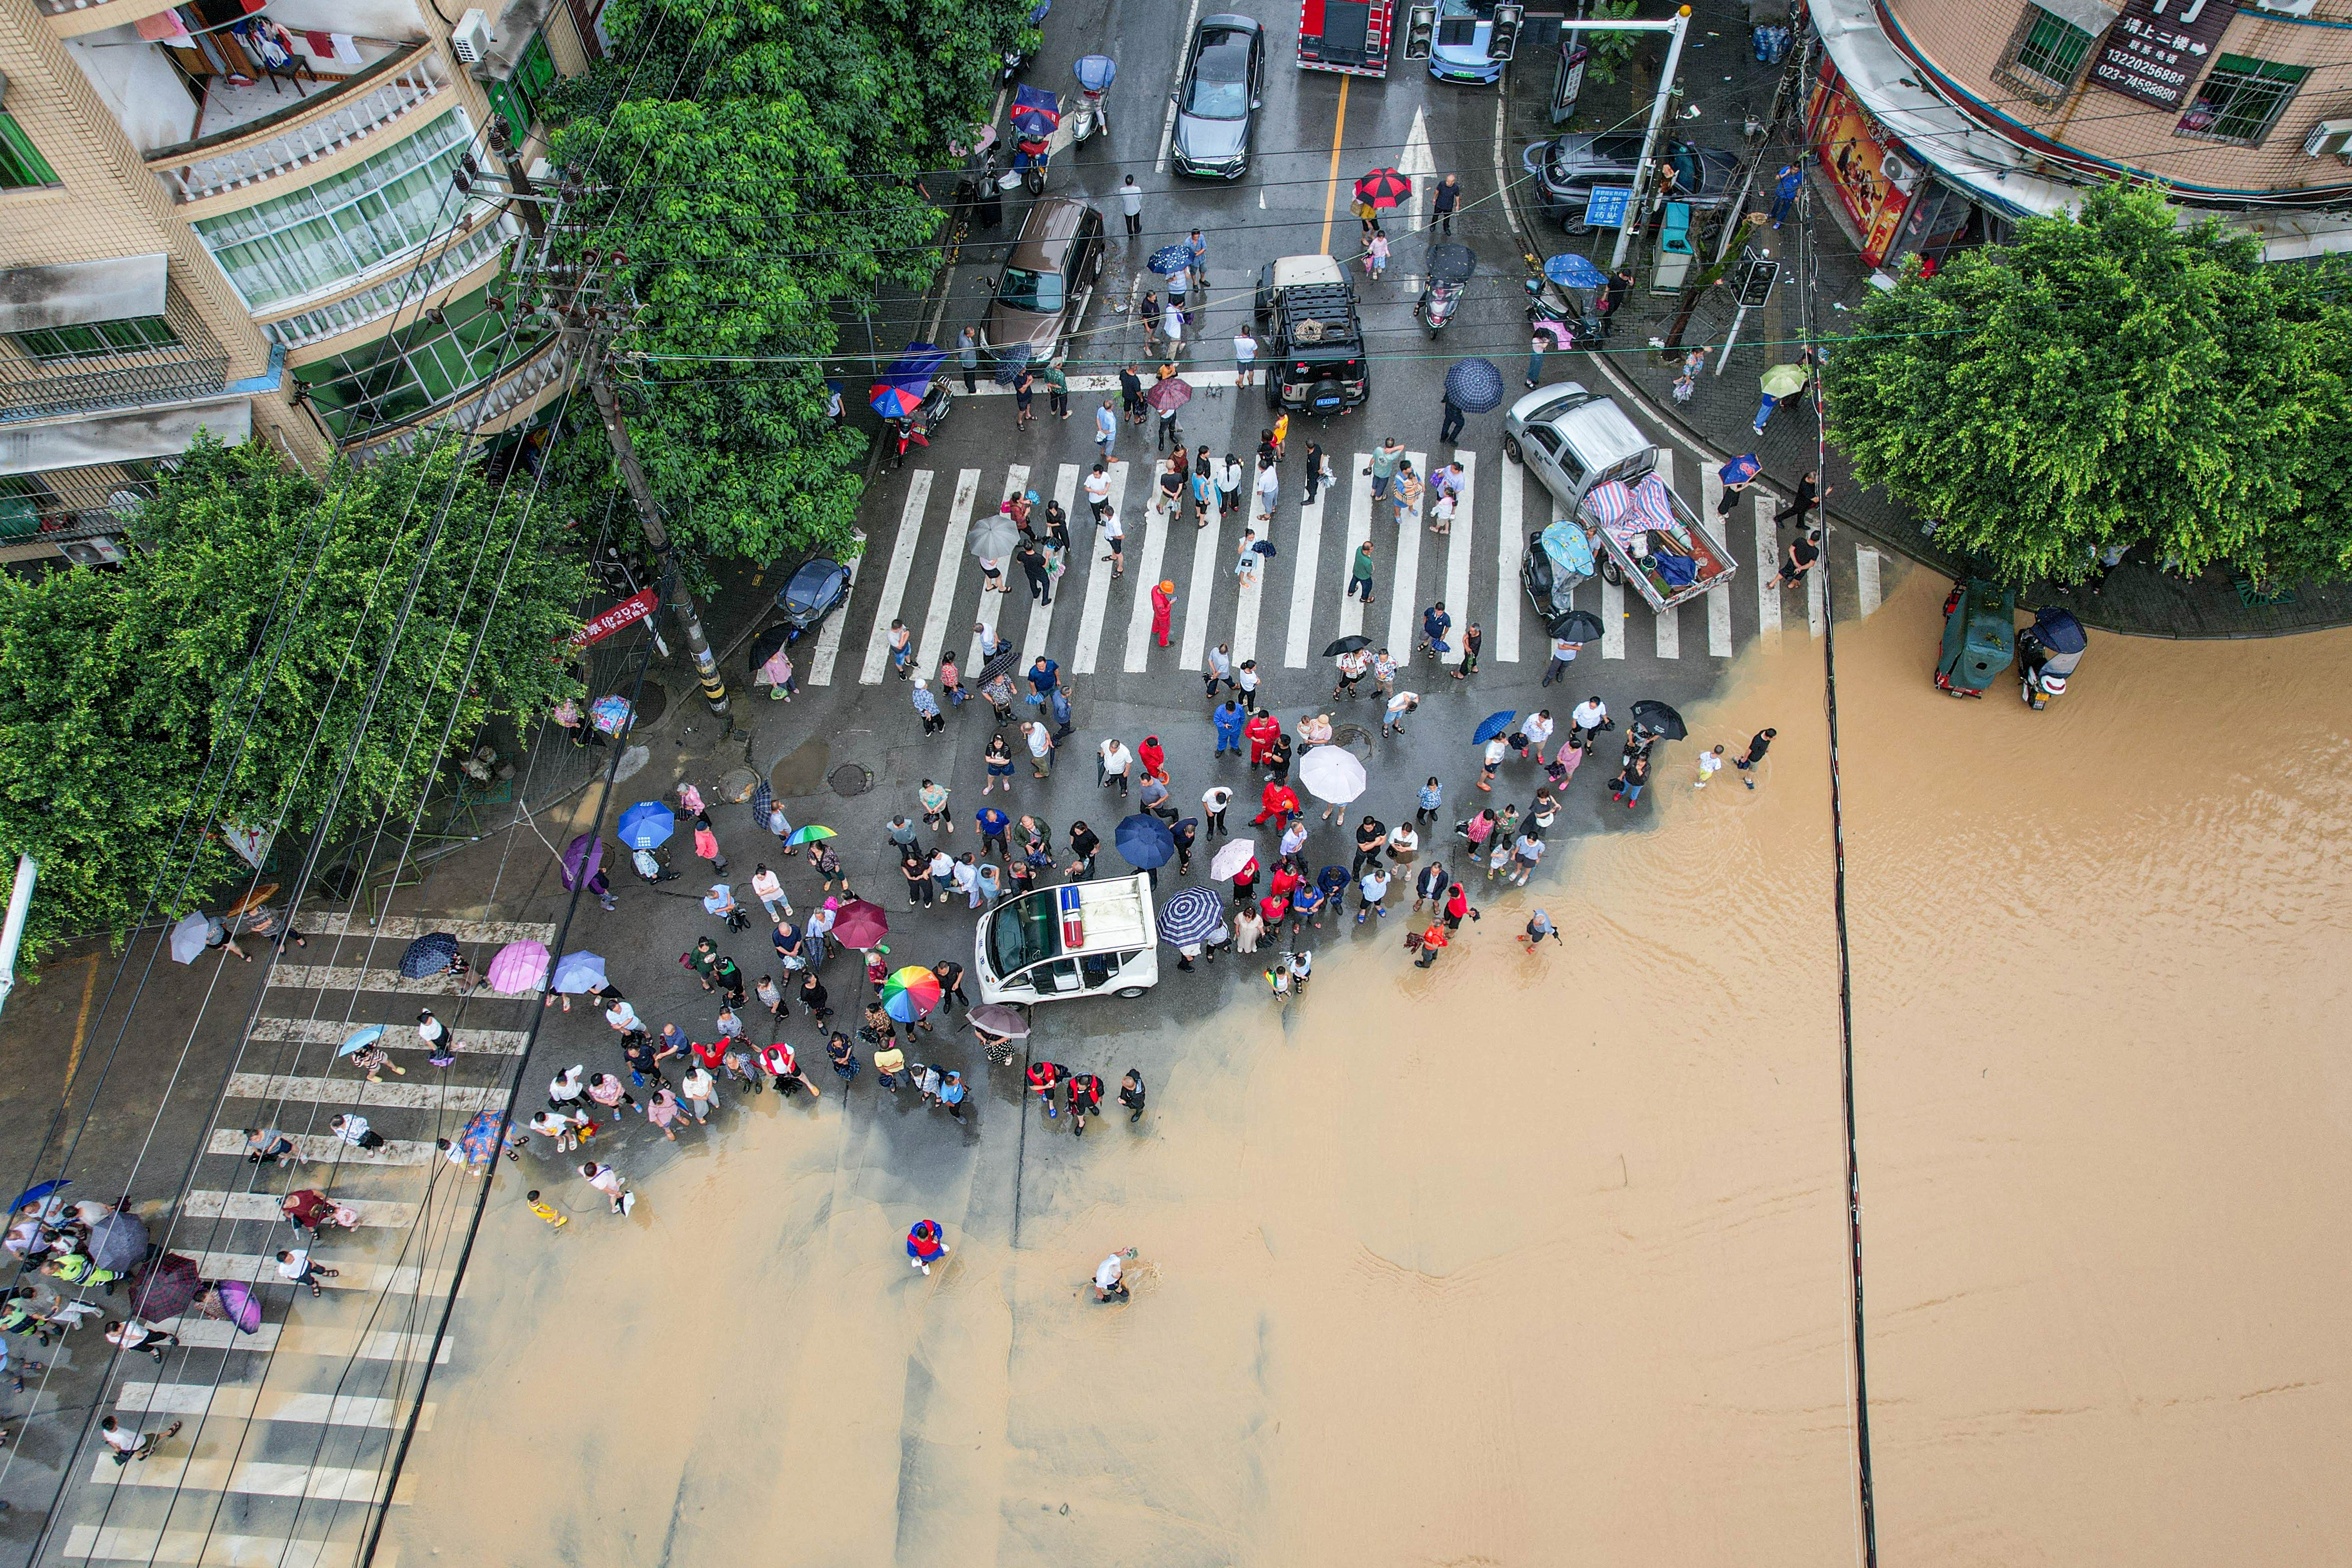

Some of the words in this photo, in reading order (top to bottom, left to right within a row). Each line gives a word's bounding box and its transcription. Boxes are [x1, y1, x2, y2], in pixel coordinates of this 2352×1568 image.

[2123, 17, 2190, 51] 请上二楼
[2107, 49, 2185, 86] 13220256888
[2128, 39, 2178, 65] 联系电话
